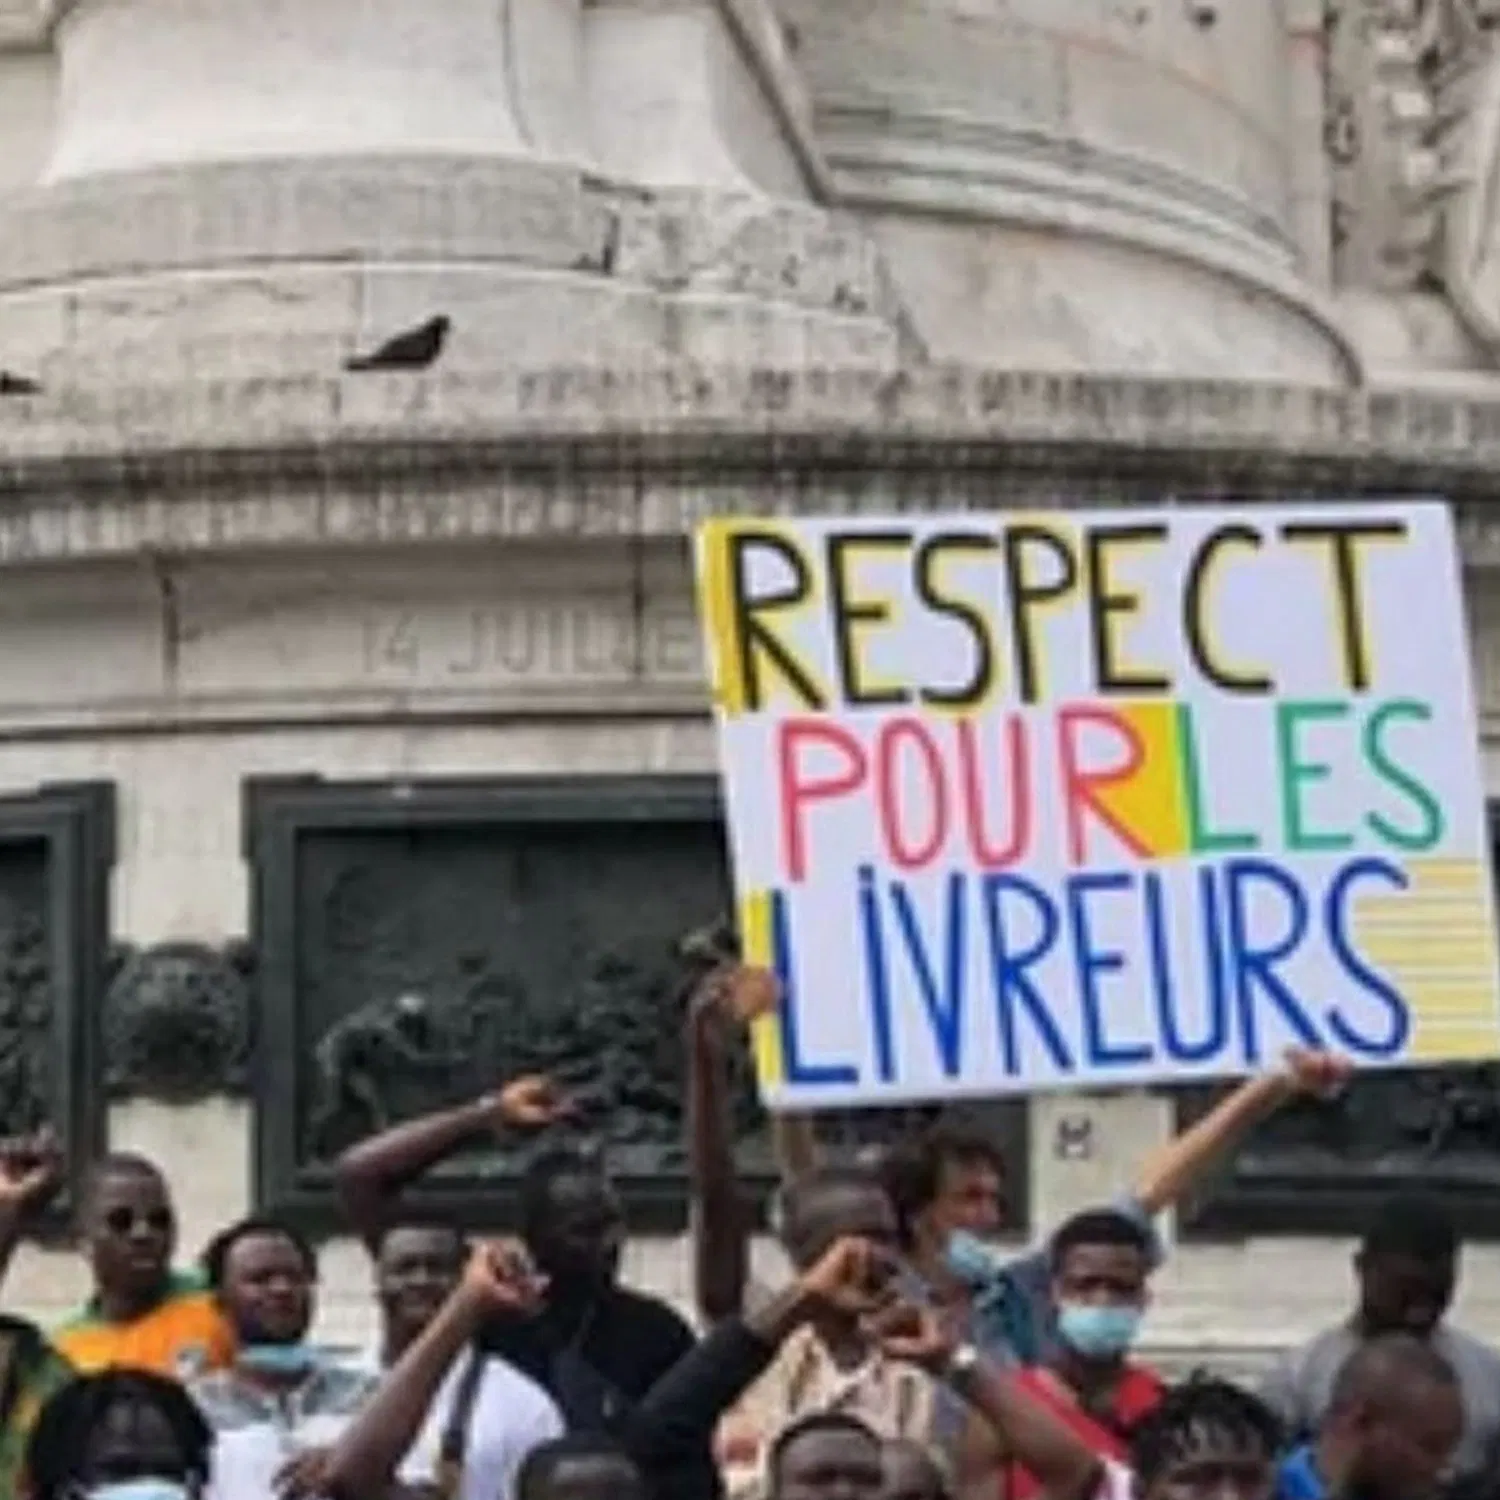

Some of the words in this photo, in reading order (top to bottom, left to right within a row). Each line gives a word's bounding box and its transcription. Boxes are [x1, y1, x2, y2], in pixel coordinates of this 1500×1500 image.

[725, 521, 1409, 711] RESPECT
[776, 700, 1156, 882] POUR
[1177, 699, 1442, 853] LES
